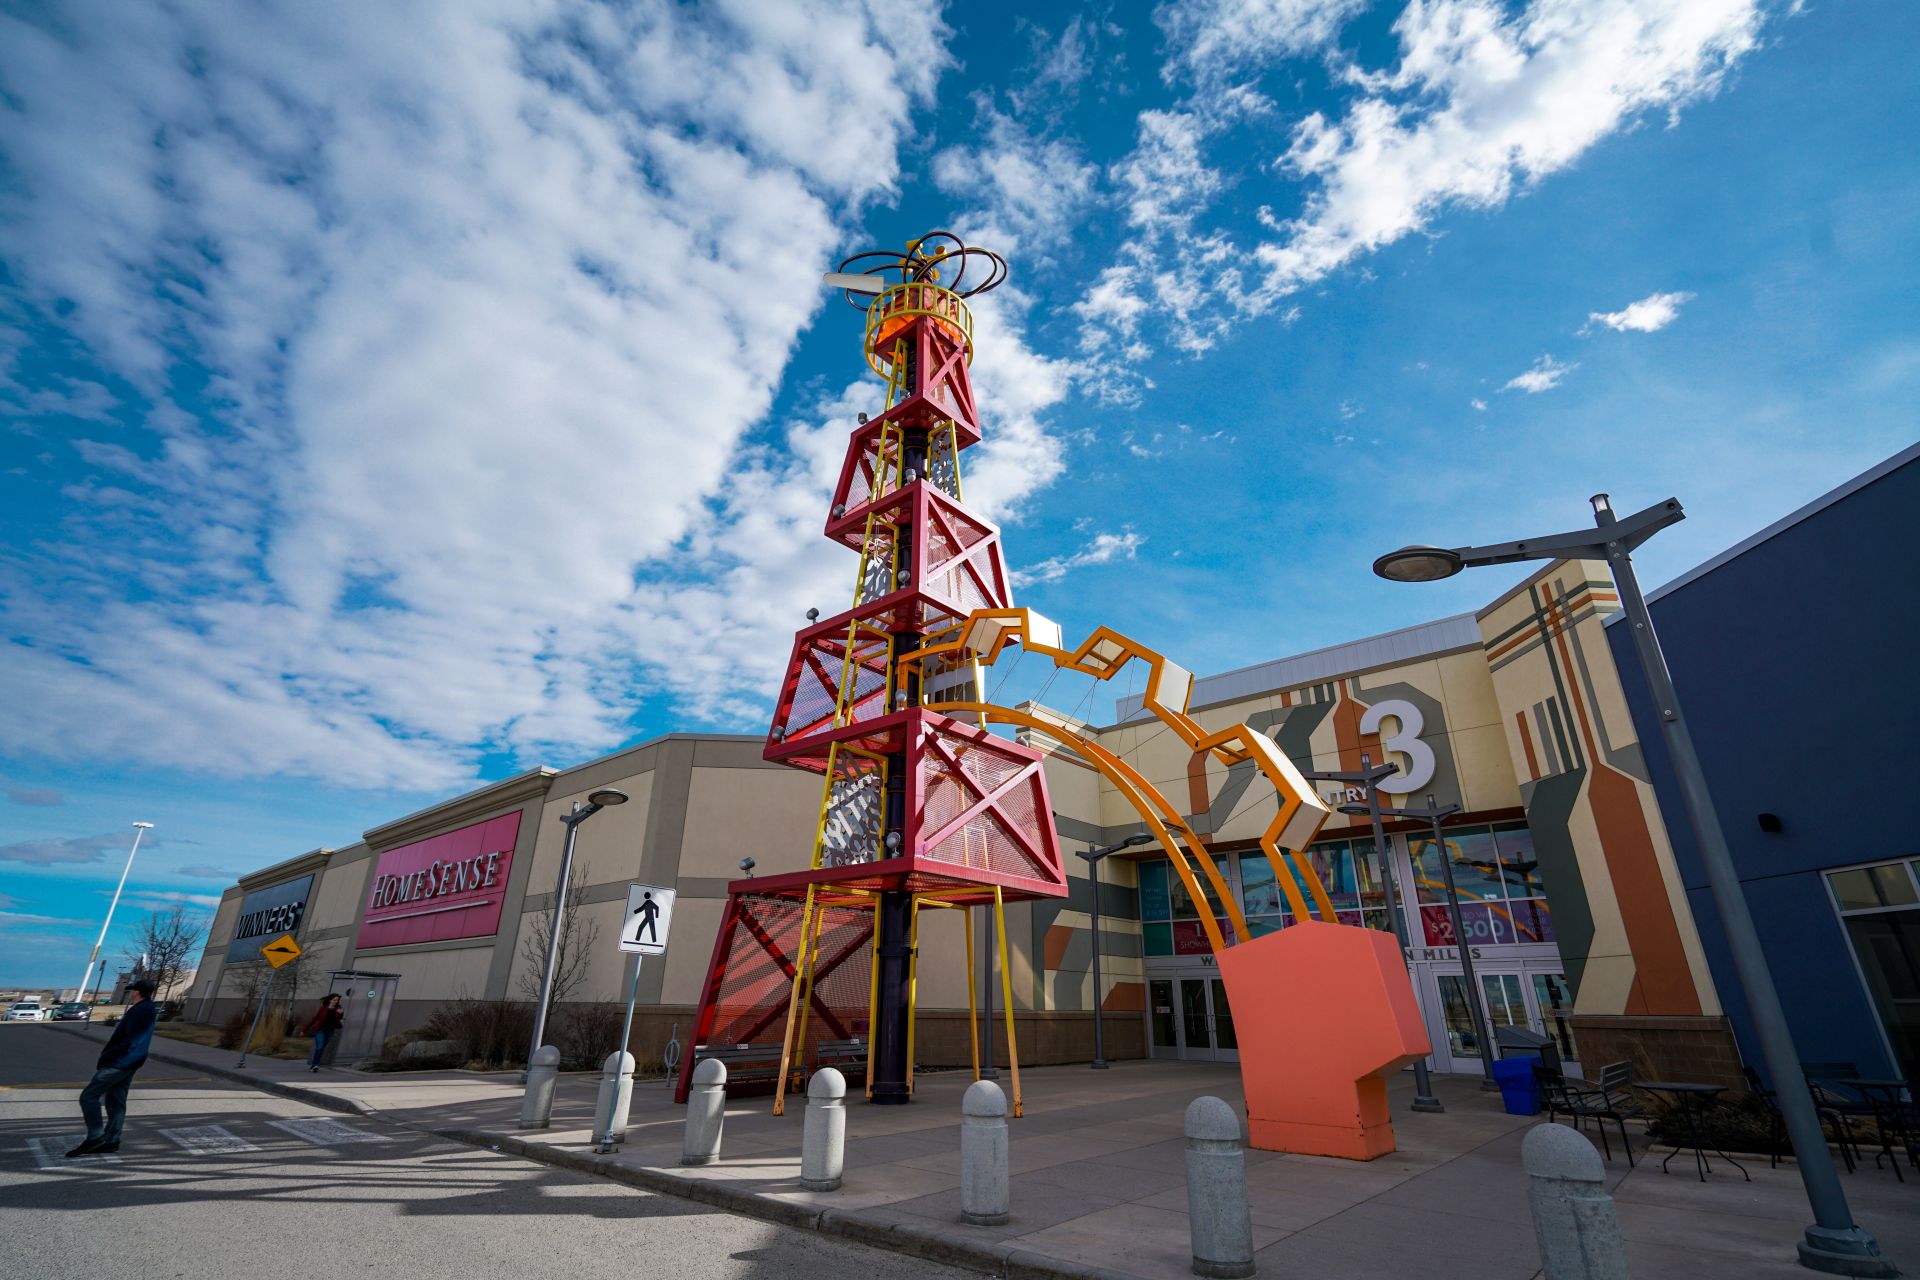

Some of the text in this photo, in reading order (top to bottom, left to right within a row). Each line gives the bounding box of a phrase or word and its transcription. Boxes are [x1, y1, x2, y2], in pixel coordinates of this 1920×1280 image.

[1319, 699, 1436, 805] NTRY 3
[236, 901, 300, 939] WINNERS
[1431, 919, 1505, 939] $2500
[1423, 948, 1482, 961] MILS
